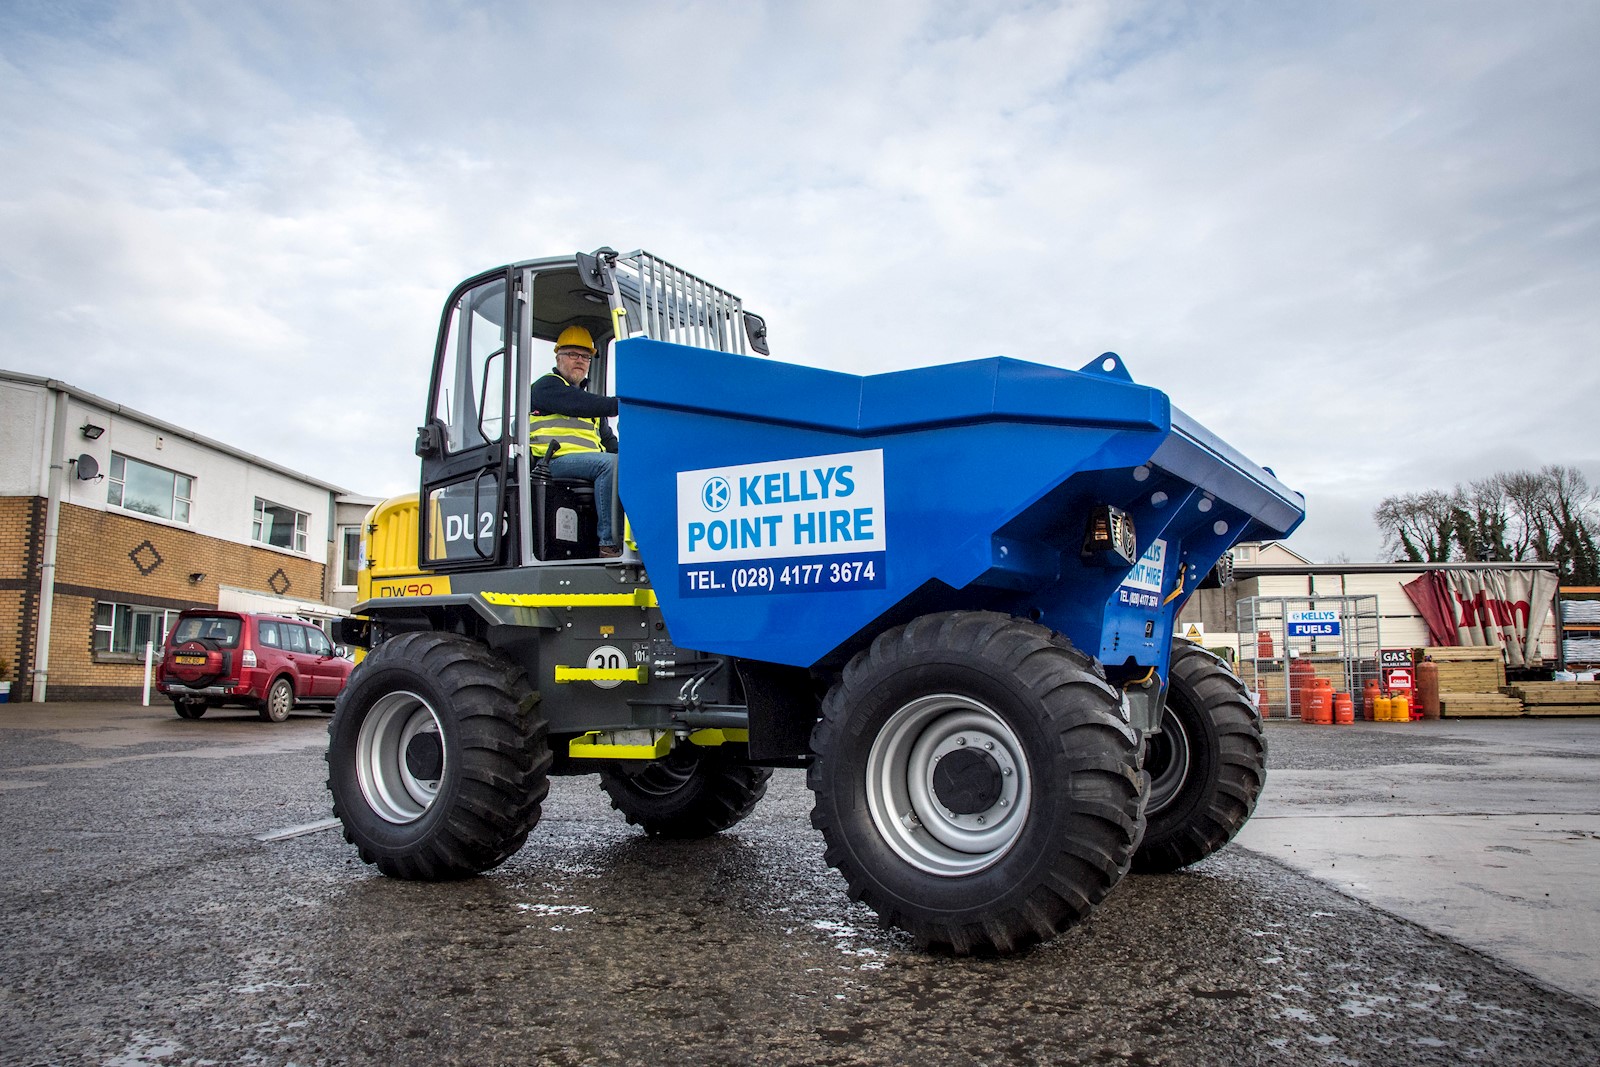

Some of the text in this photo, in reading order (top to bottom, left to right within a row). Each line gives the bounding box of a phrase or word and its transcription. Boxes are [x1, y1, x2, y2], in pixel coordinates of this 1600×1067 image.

[739, 465, 855, 507] KELLYS
[688, 507, 874, 552] POINT HIRE
[687, 561, 875, 592] TEL. (028) 4177 3674
[1145, 566, 1162, 586] HIRE
[380, 583, 433, 598] DW90
[1301, 611, 1335, 620] KELLYS
[1295, 625, 1333, 634] FUELS
[634, 650, 646, 662] 101
[1383, 652, 1405, 662] GAS
